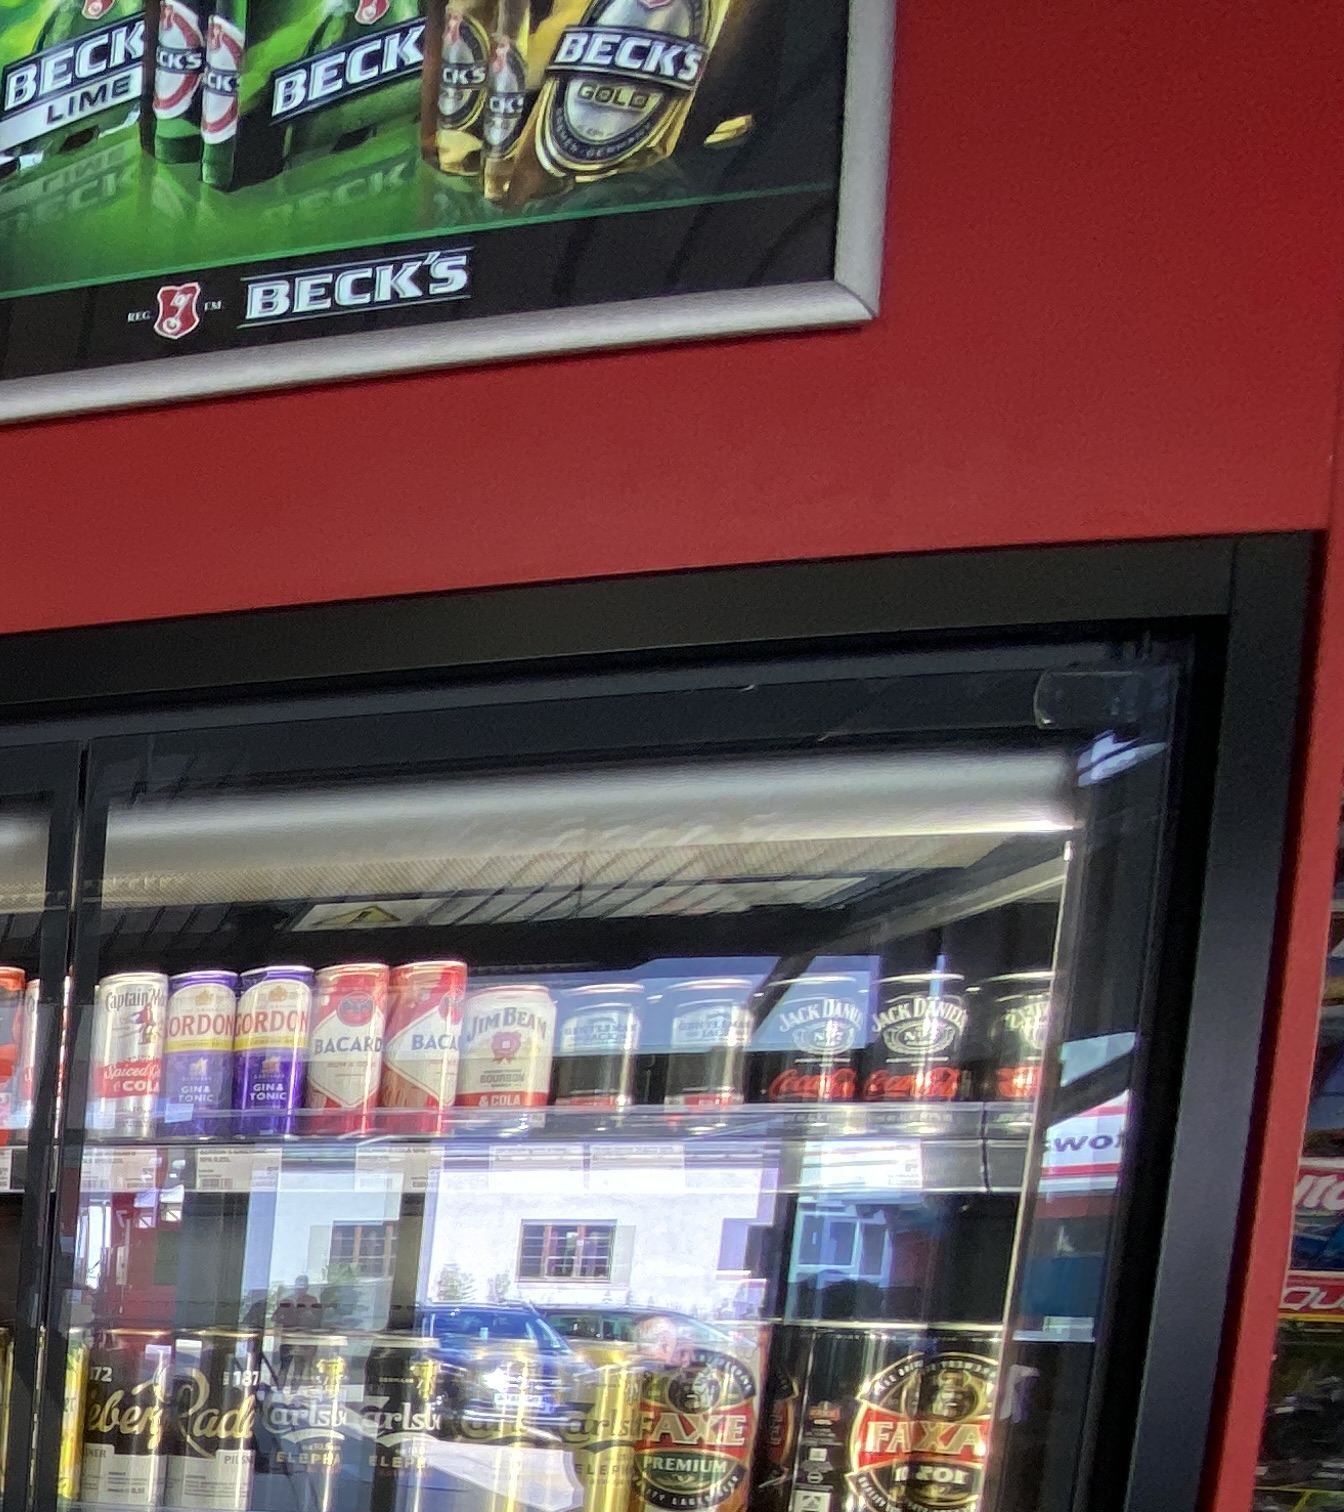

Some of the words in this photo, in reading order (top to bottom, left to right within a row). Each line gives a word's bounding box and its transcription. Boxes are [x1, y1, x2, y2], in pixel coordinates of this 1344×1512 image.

[556, 31, 703, 81] BECK'S
[47, 74, 134, 126] LIME
[578, 84, 650, 111] GOLD
[246, 251, 468, 320] BECK'S
[465, 1014, 502, 1043] JIM
[502, 1004, 549, 1040] BEAM
[778, 998, 820, 1033] JACK
[871, 997, 912, 1032] JACK
[249, 1091, 287, 1102] TONIC
[490, 1092, 522, 1107] COLA
[643, 1454, 728, 1476] PREMIUM
